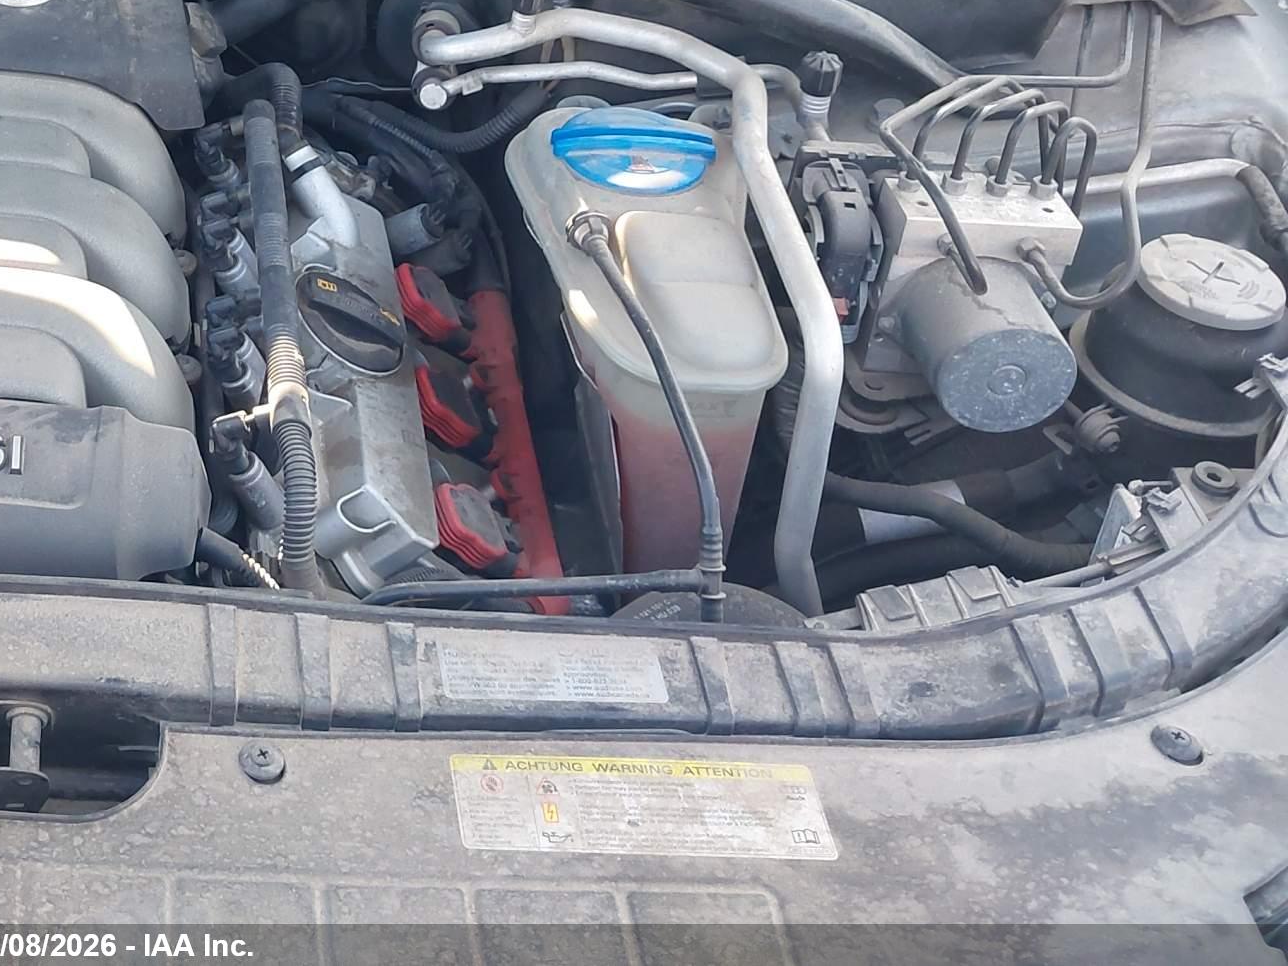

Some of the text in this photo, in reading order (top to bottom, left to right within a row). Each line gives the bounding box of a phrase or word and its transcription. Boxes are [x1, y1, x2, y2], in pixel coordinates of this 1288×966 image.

[505, 760, 773, 779] ACHTUNG WARNING ATTENTION
